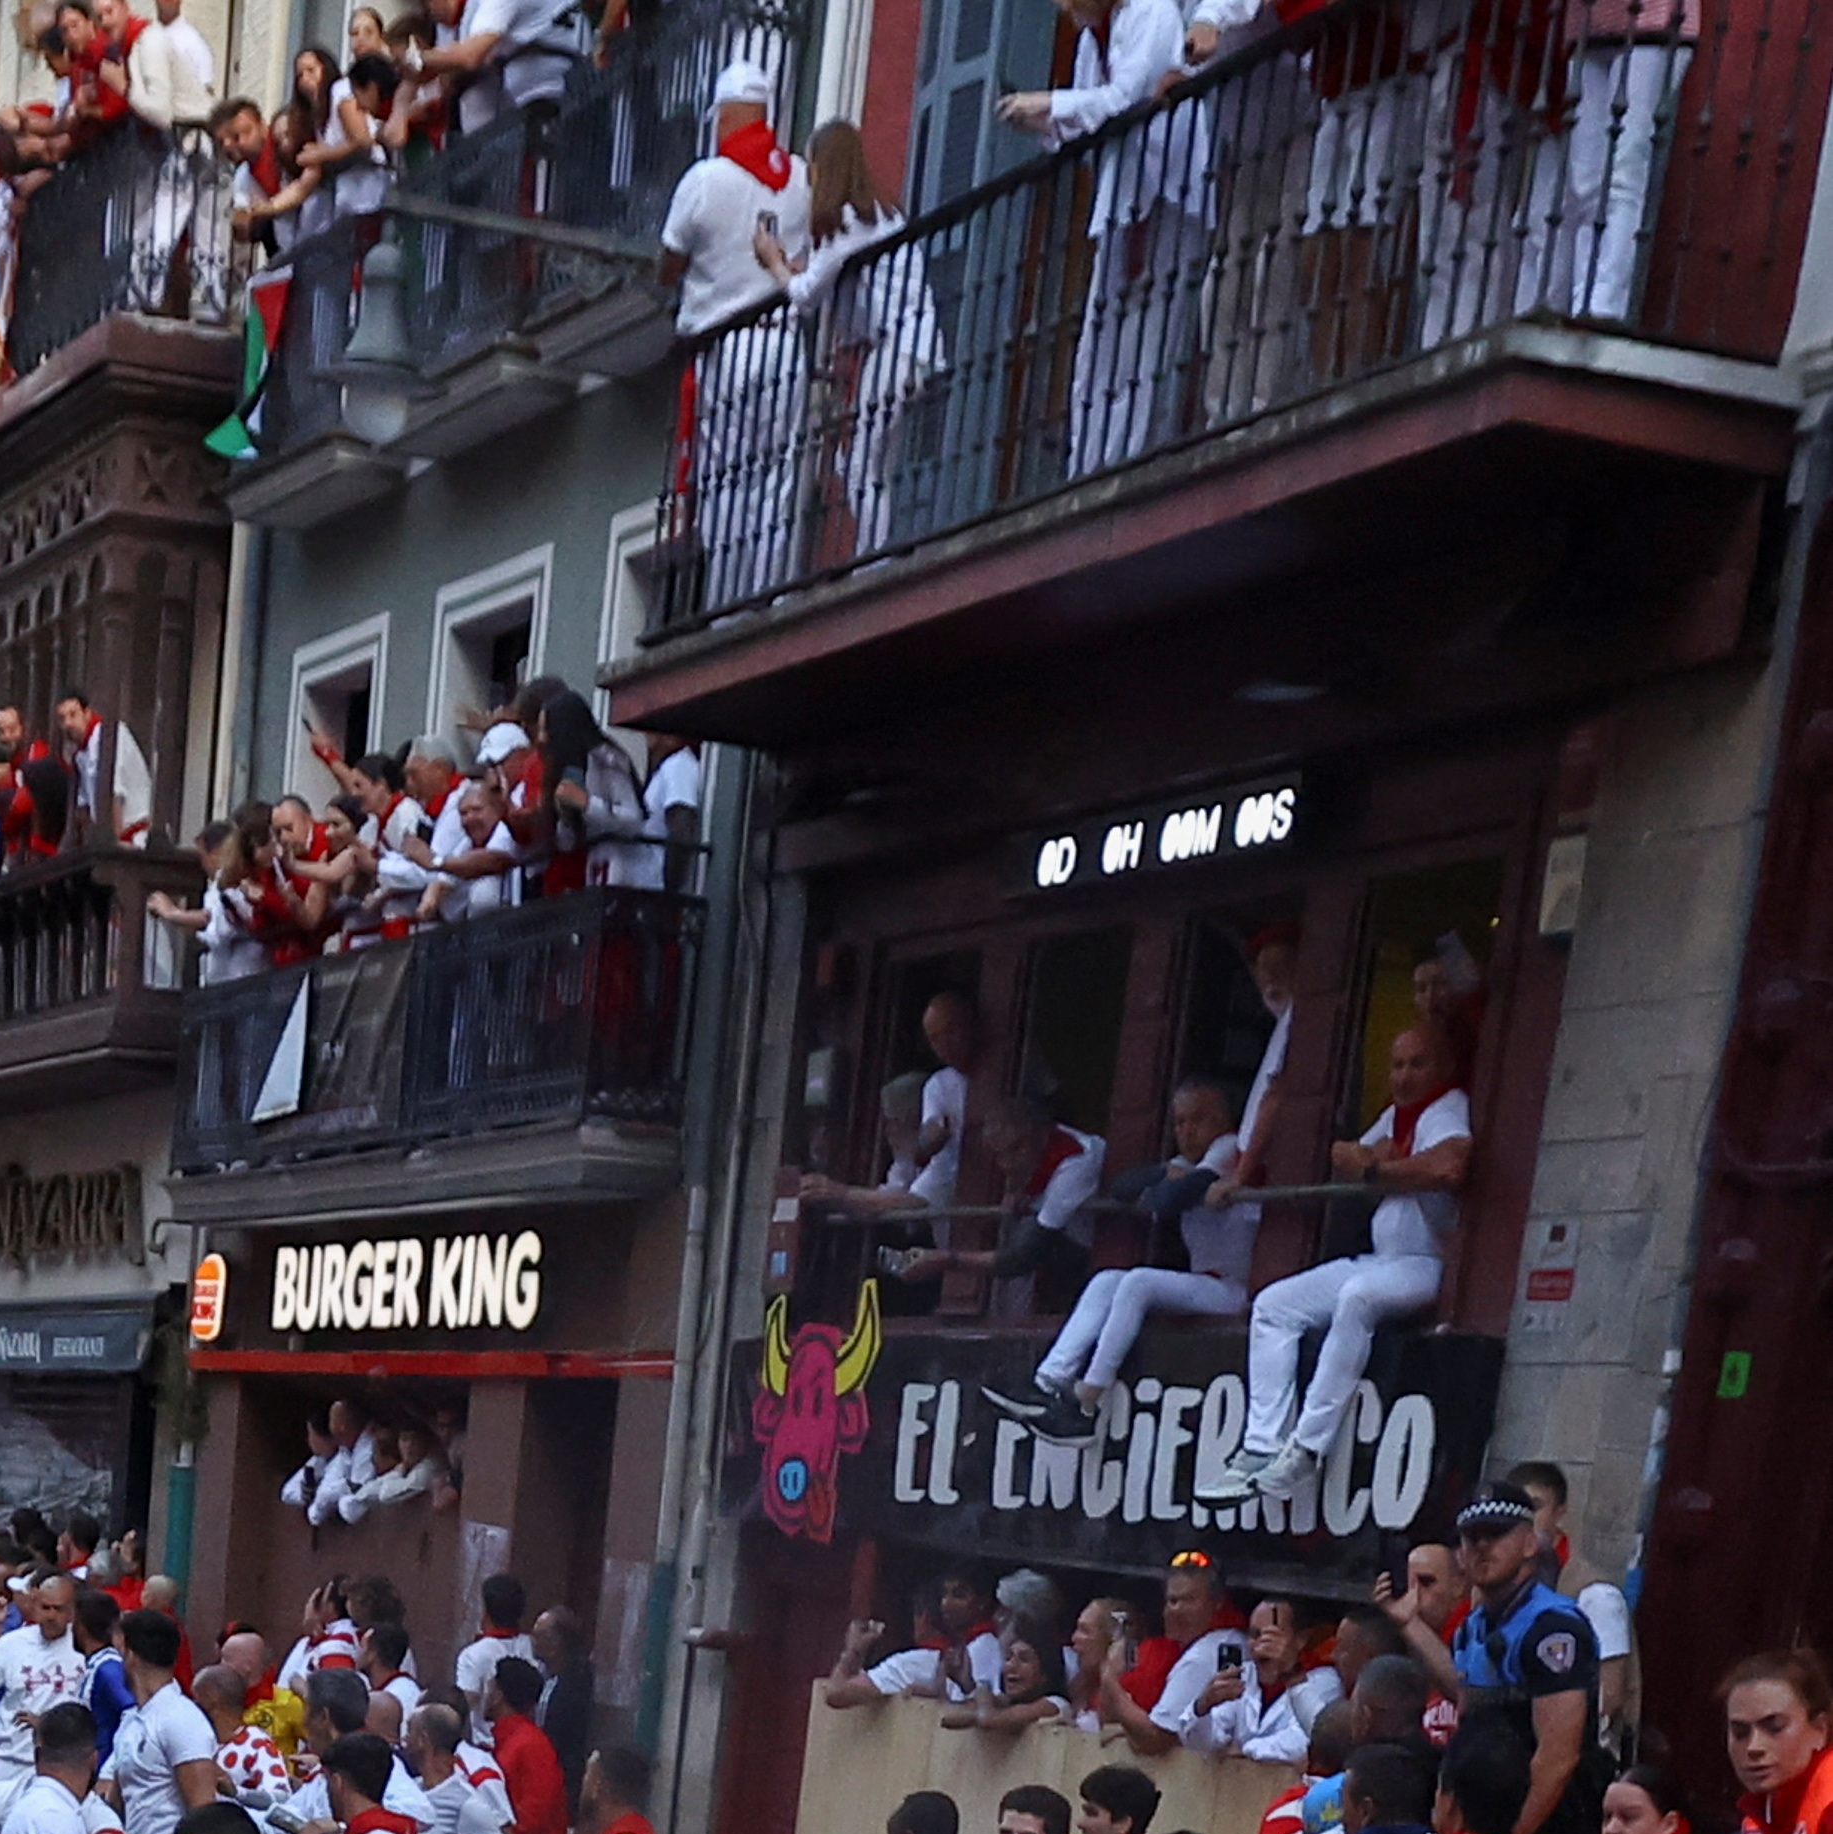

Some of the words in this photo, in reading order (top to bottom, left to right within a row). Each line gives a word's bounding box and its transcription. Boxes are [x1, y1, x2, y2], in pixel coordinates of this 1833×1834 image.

[271, 1238, 424, 1332] BURGER
[428, 1230, 541, 1332] KING
[893, 1379, 961, 1505] EL
